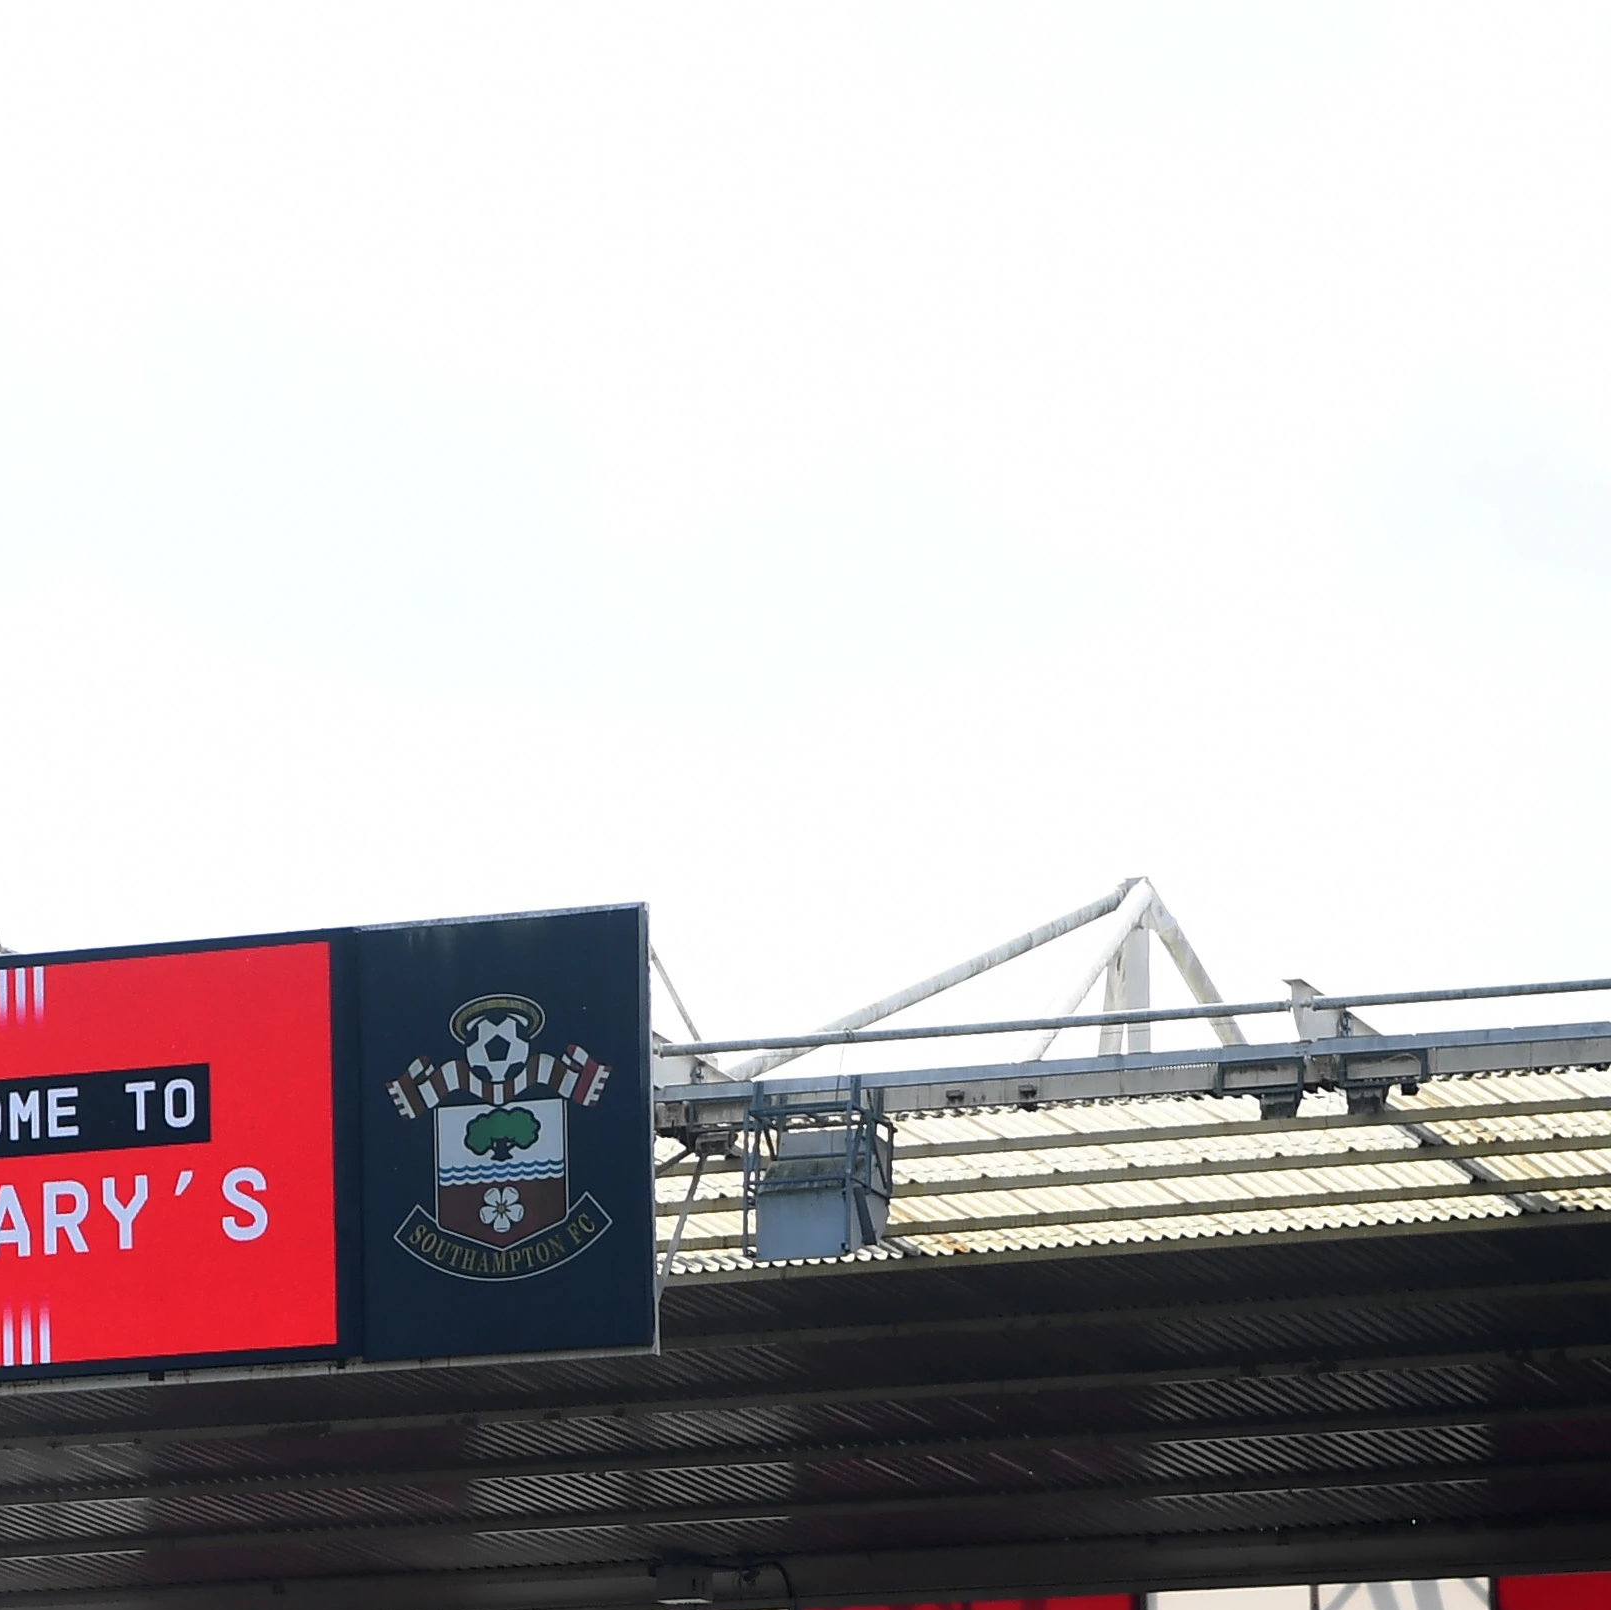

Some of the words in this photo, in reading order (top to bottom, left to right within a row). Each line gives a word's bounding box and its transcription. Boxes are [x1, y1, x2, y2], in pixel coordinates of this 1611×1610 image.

[125, 1078, 196, 1132] TO
[409, 1223, 567, 1274] SOUTHAMPTON
[566, 1213, 596, 1245] FC
